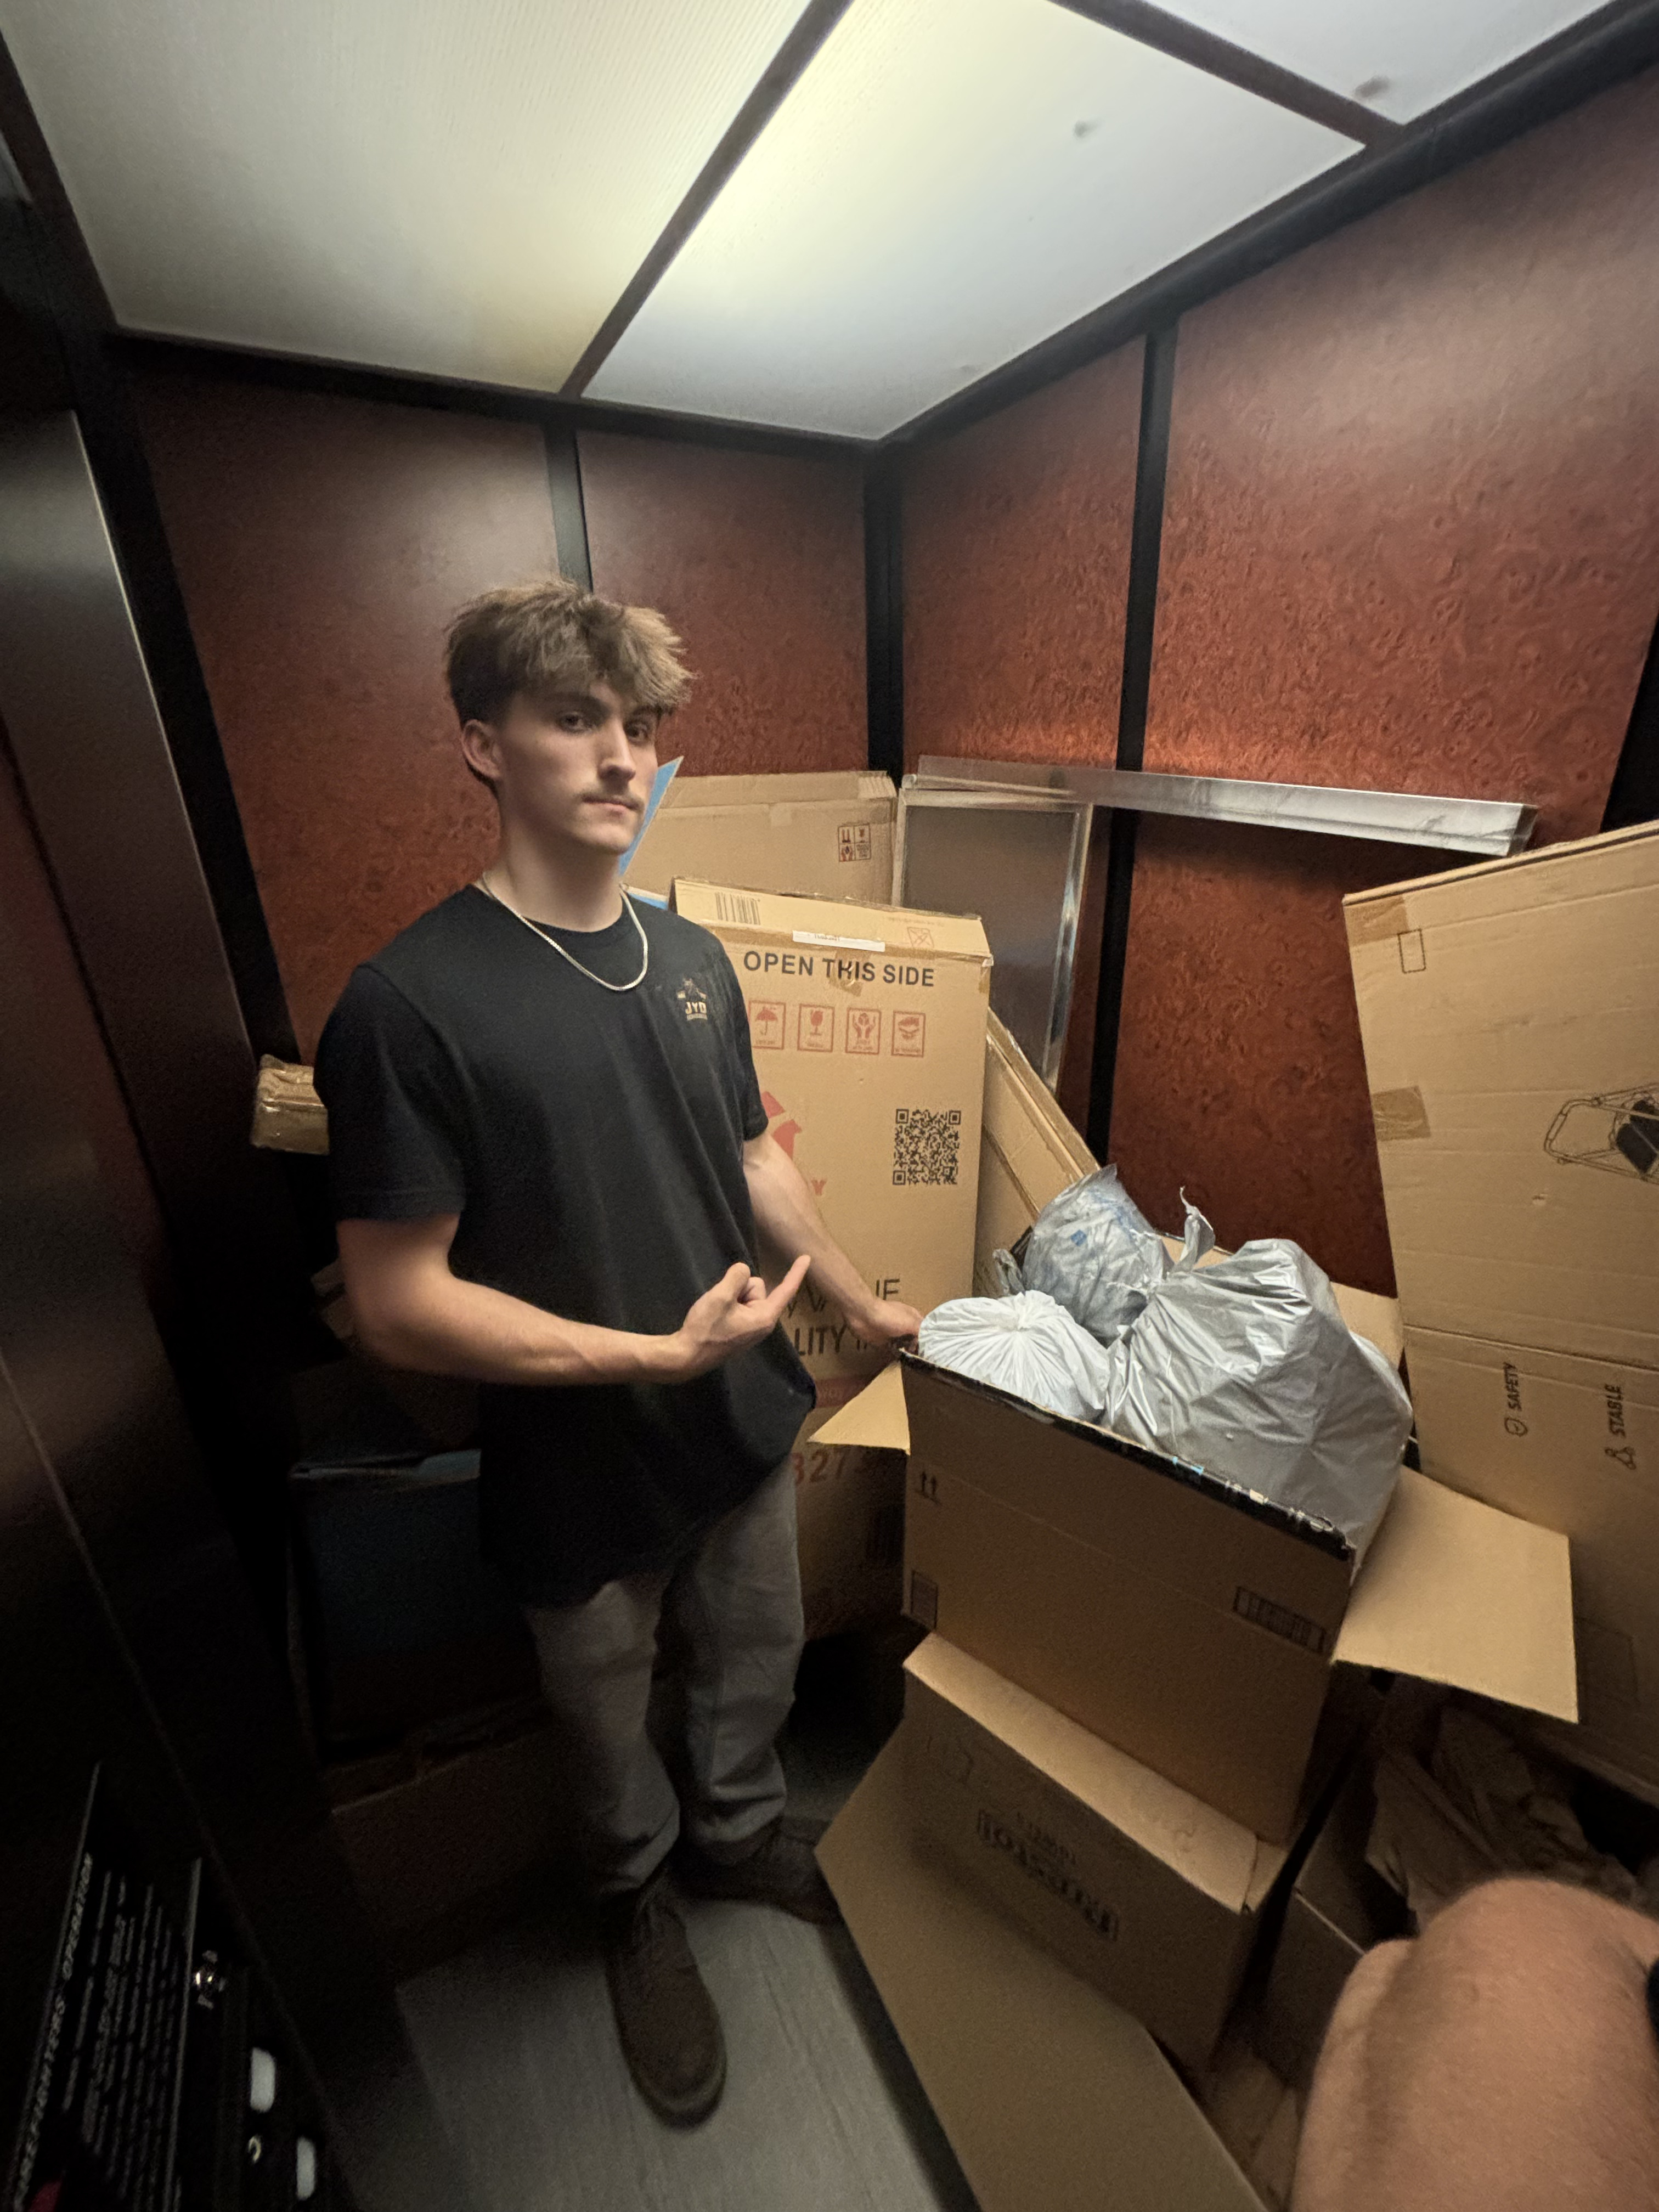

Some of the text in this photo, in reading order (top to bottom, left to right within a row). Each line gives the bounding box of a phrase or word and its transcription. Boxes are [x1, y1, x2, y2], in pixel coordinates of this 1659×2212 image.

[743, 950, 935, 987] OPEN THIS SIDE
[1503, 1362, 1522, 1412] SAFETY
[1604, 1383, 1626, 1438] STABLE
